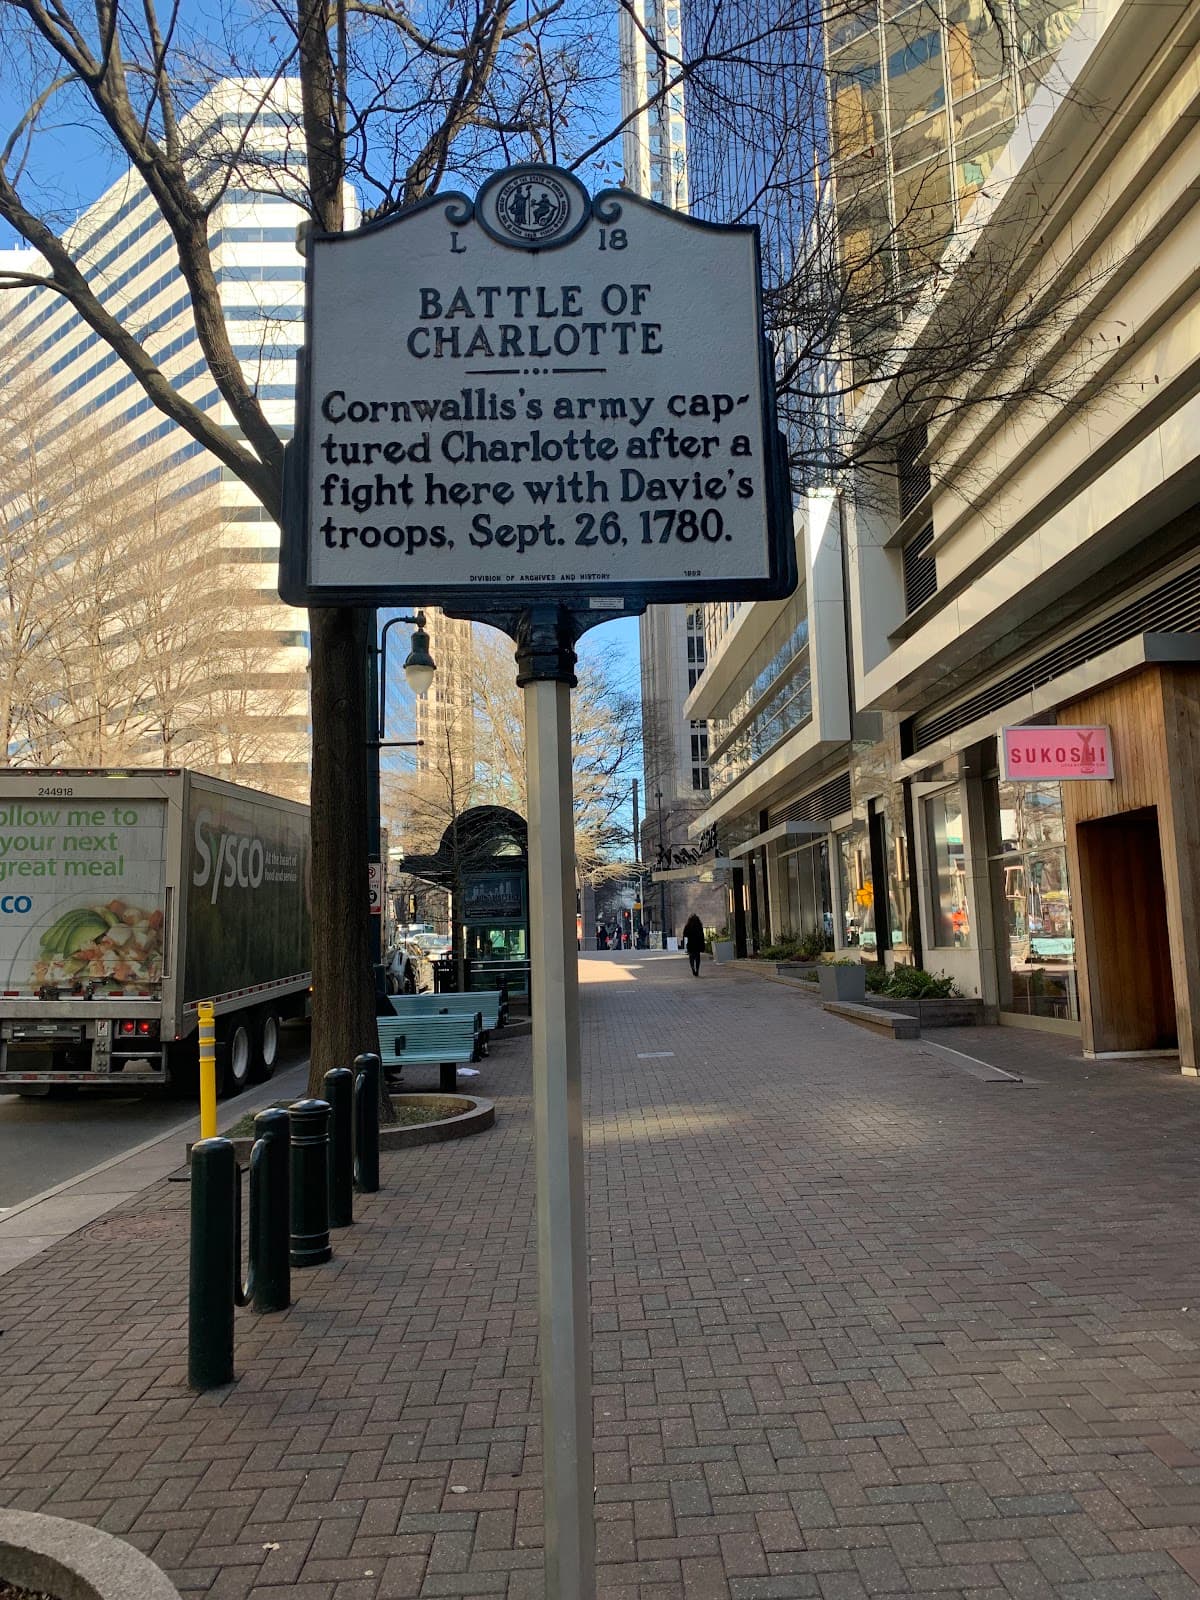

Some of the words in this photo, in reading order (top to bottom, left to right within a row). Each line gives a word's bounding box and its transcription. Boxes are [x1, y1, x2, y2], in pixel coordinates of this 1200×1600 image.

[450, 232, 467, 254] L
[598, 229, 628, 251] 18
[419, 286, 583, 320] BATTLE
[601, 284, 651, 316] OF
[407, 322, 663, 359] CHARLOTTE
[321, 388, 543, 425] Cornwallis's
[554, 398, 655, 427] army
[667, 394, 749, 424] cap-
[321, 432, 431, 466] tured
[441, 429, 618, 464] Charlotte
[626, 427, 719, 459] after
[730, 435, 752, 456] a
[320, 474, 413, 513] fight
[425, 473, 514, 507] here
[523, 470, 609, 504] with
[620, 469, 753, 502] Davie's
[320, 517, 454, 555] troops,
[469, 514, 565, 554] Sept.
[575, 511, 627, 547] 26,
[640, 508, 732, 544] 1780.
[520, 574, 556, 582] ARCHIVES
[38, 787, 73, 796] 244918
[67, 810, 105, 826] me
[112, 807, 138, 826] to
[0, 835, 56, 857] your
[63, 832, 118, 851] next
[271, 849, 280, 865] the
[64, 855, 124, 876] meal
